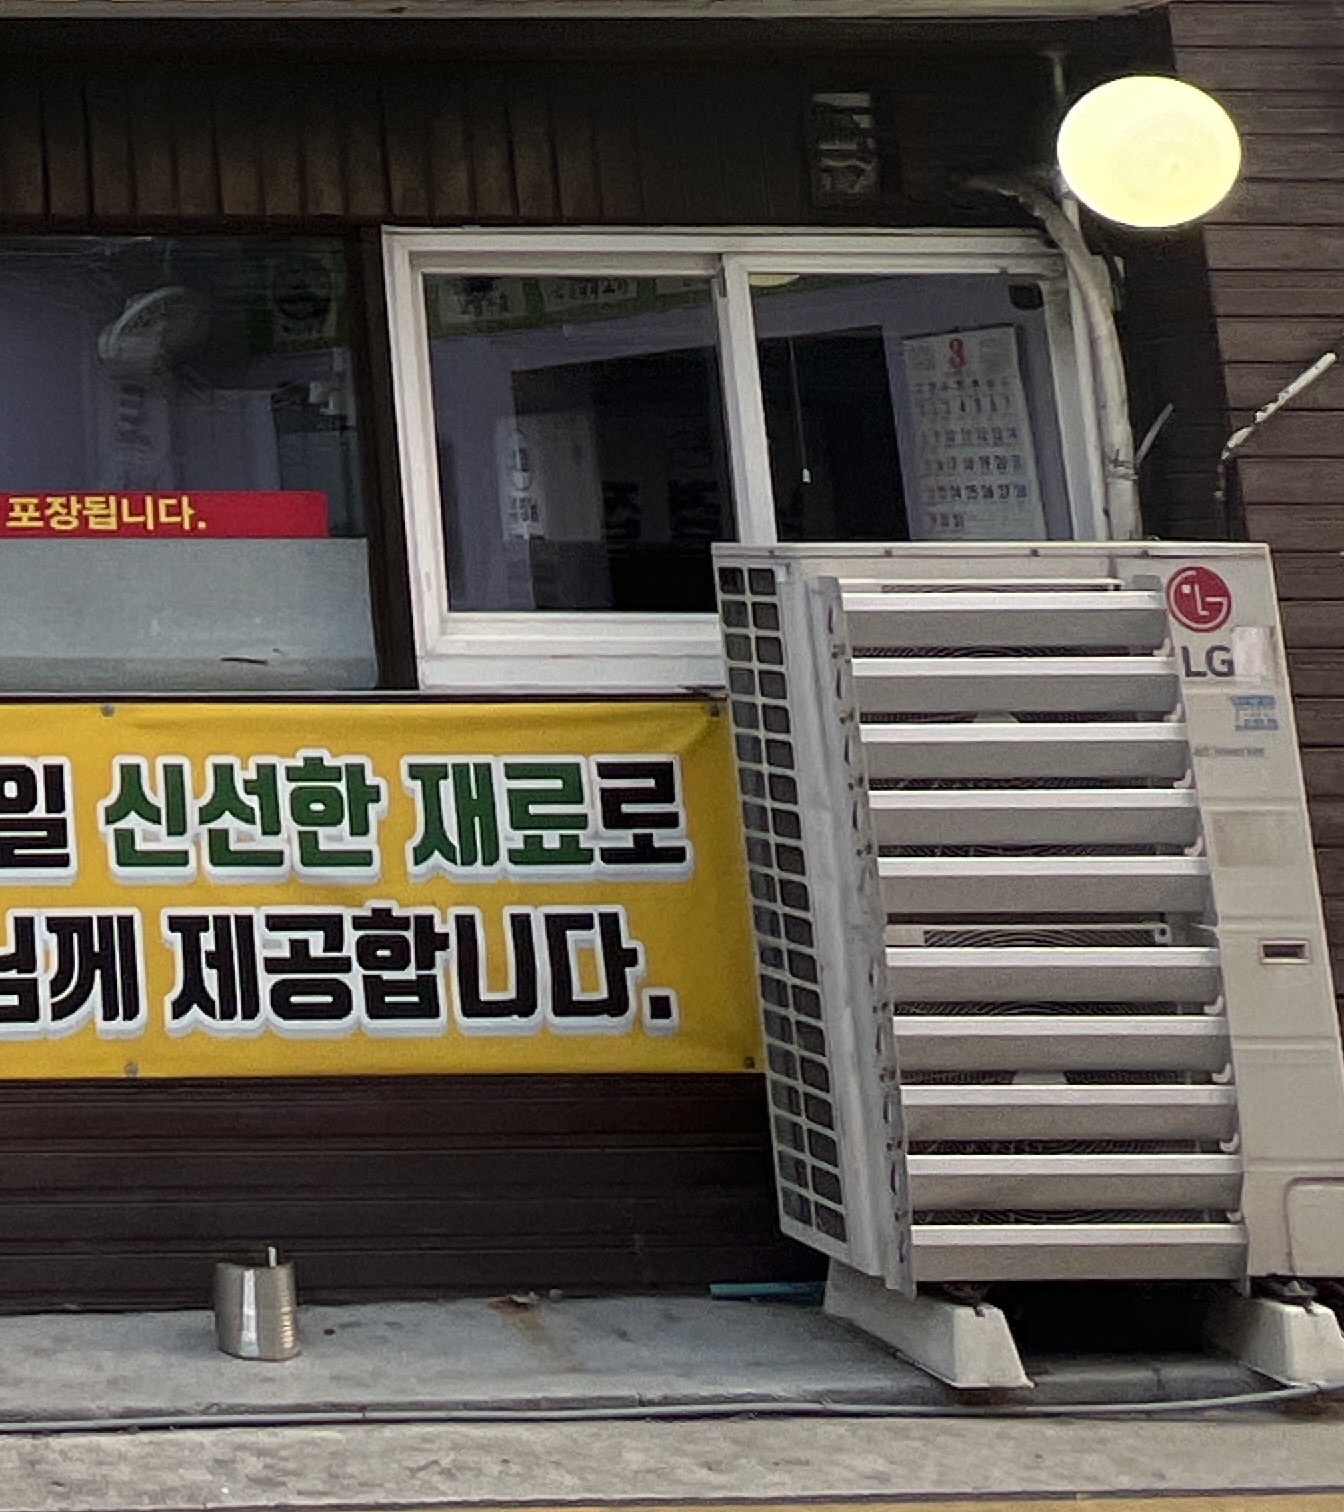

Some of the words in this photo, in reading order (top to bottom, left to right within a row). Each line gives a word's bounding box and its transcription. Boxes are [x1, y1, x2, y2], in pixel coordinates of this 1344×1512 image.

[5, 496, 208, 531] 포장됩니다.
[1180, 644, 1235, 679] LG
[102, 754, 384, 870] 신선한
[405, 758, 688, 870] 재료로
[166, 904, 677, 1023] 제공합니다.
